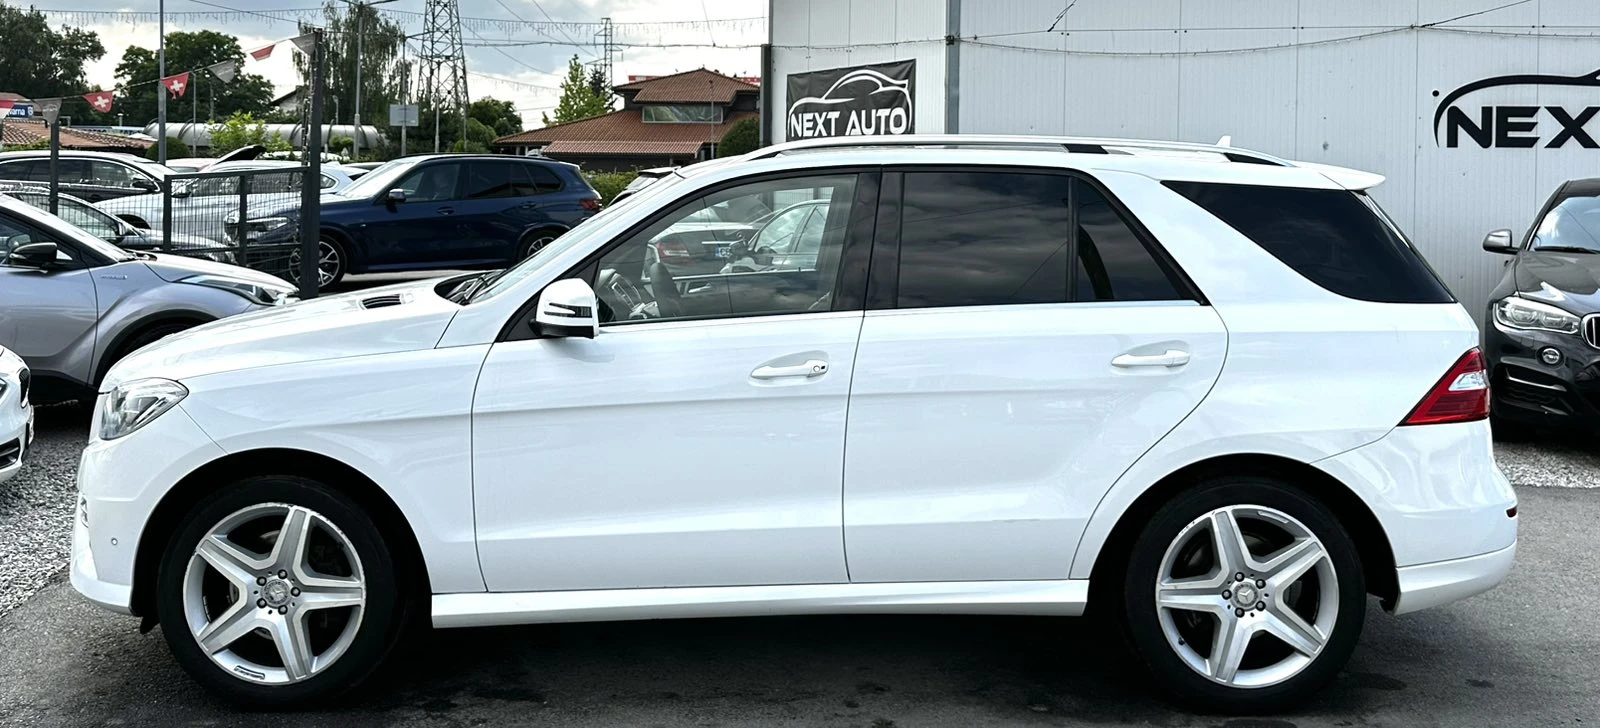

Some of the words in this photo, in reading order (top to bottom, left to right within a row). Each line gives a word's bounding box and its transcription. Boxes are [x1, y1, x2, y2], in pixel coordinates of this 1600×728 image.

[791, 111, 840, 137] NEXT
[845, 107, 907, 136] AUTO
[1446, 106, 1600, 148] NEX
